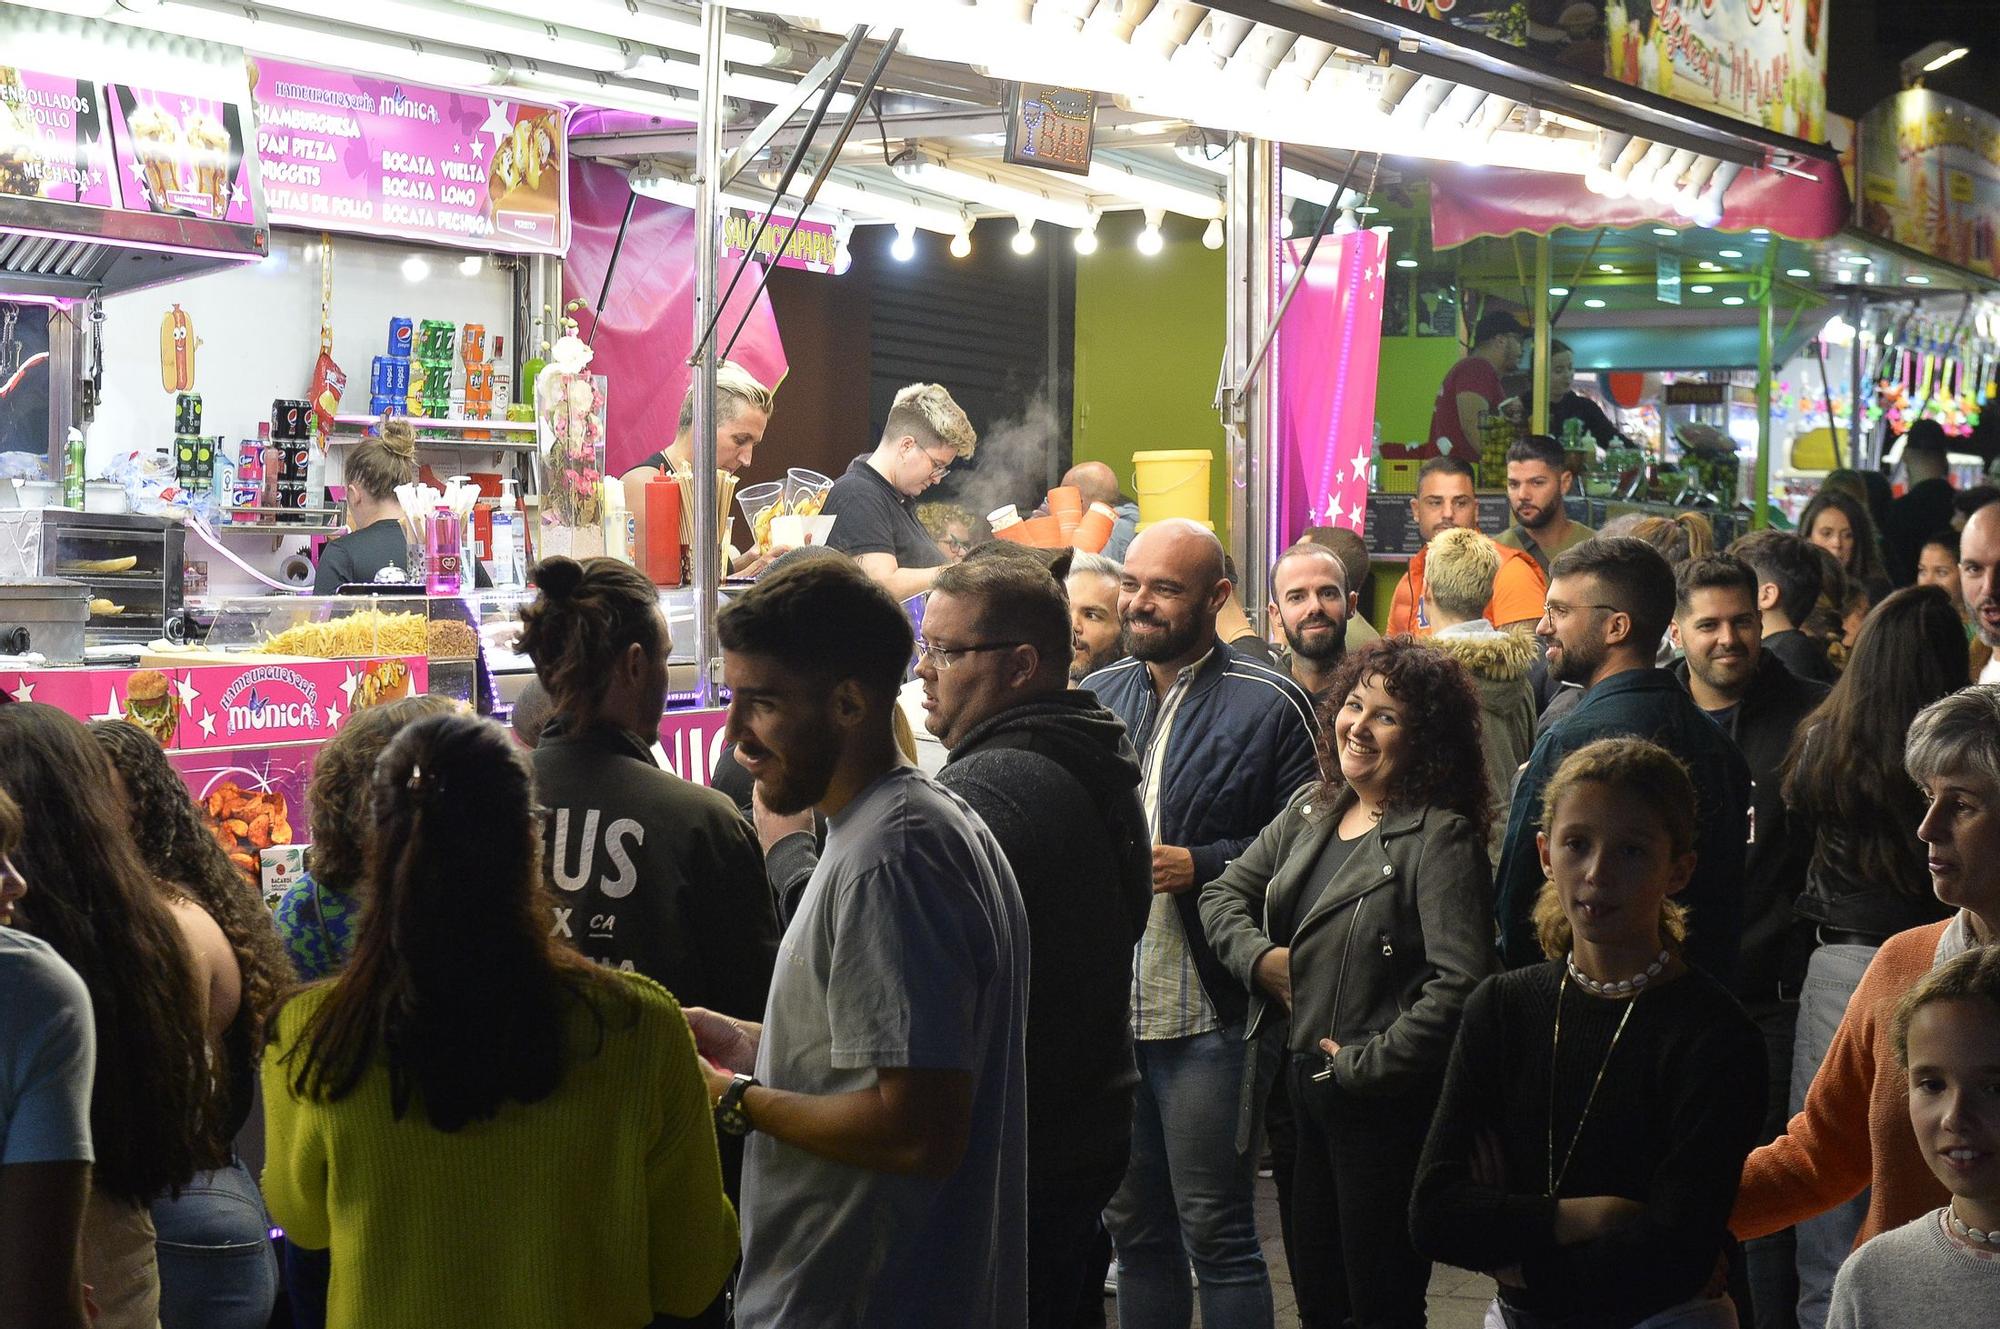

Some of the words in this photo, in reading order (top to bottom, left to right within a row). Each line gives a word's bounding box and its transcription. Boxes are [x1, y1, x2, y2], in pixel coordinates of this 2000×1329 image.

[1, 86, 90, 114] ENROLLADOS
[26, 108, 71, 129] POLLO
[259, 103, 361, 139] HAMBURGUESA
[259, 132, 289, 156] PAN
[292, 137, 337, 163] PIZZA
[22, 161, 91, 186] MECHADA
[260, 160, 321, 187] NUGGETS
[382, 150, 435, 177] BOCATA
[440, 159, 486, 184] VUELTA
[382, 176, 435, 201] BOCATA
[441, 185, 476, 208] LOMO
[311, 193, 329, 214] DE
[331, 196, 374, 220] POLLO
[382, 203, 435, 228] BOCATA
[438, 210, 495, 235] PECHUGA
[589, 914, 616, 931] CA
